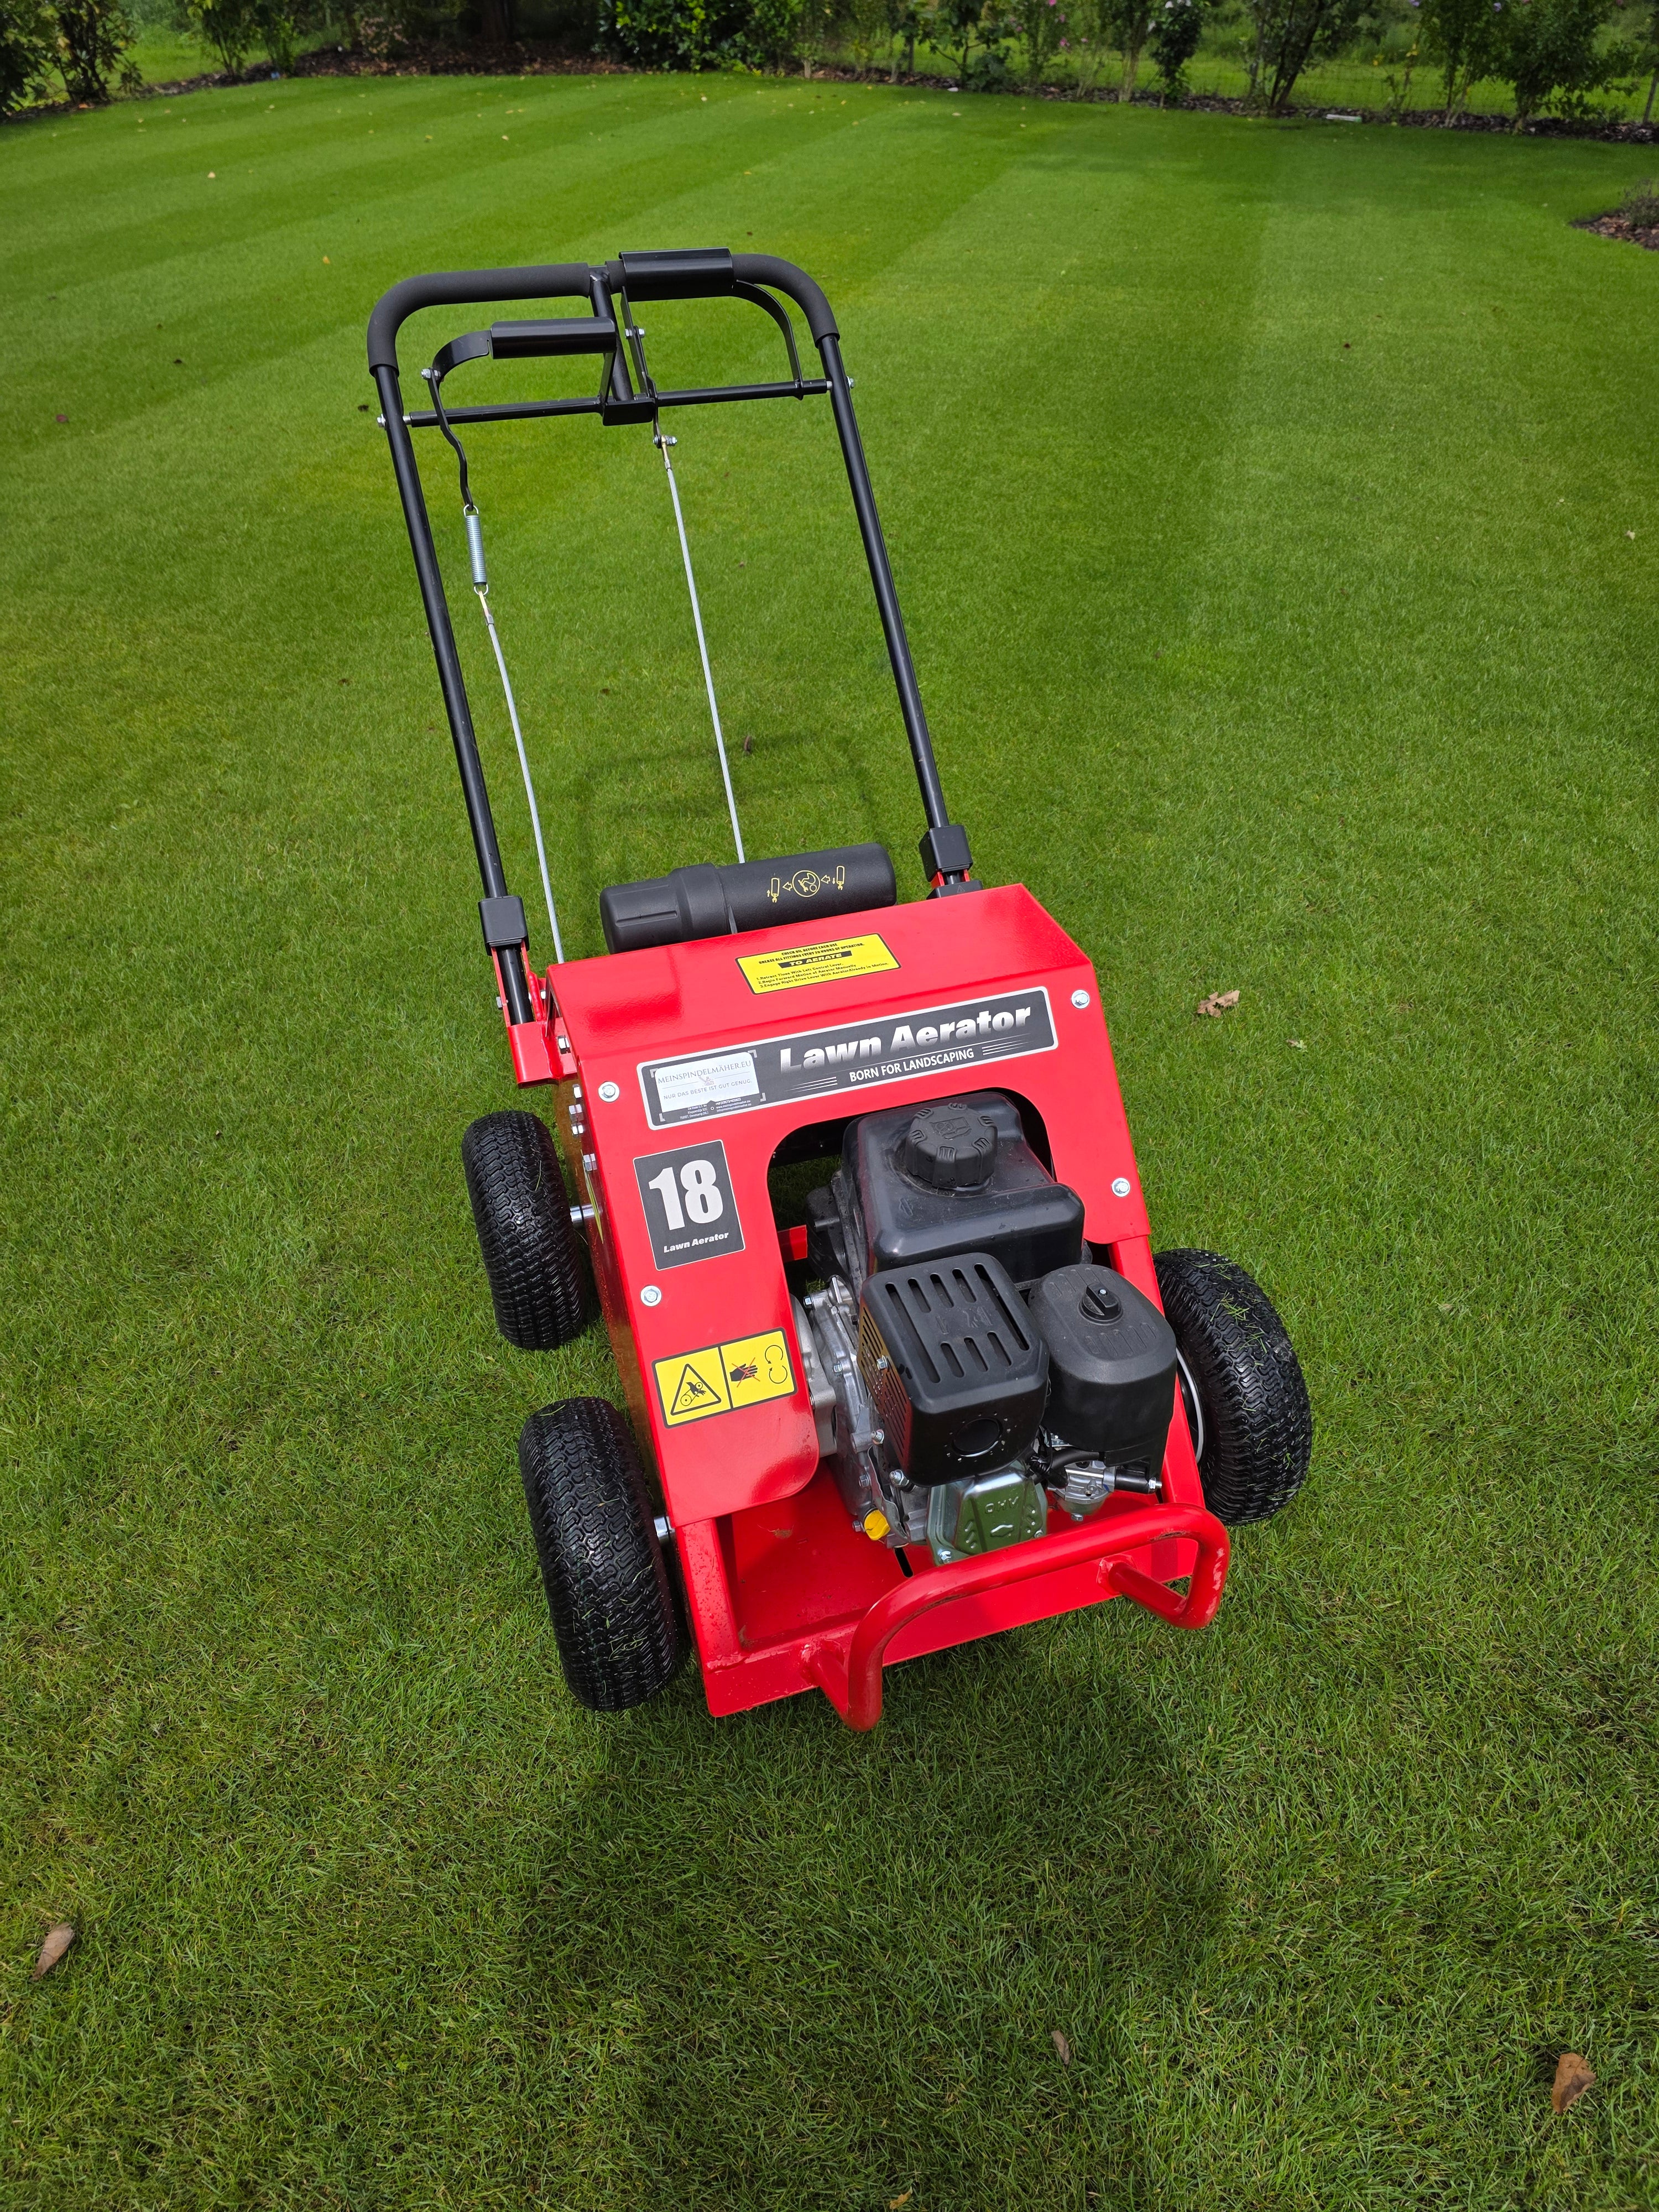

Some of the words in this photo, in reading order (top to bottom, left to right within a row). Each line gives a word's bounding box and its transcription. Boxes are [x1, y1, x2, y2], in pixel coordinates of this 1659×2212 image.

[806, 953, 842, 963] AERATE
[780, 1036, 881, 1074] Lawn
[890, 1006, 1031, 1051] Aerator
[658, 1060, 752, 1084] MEINSPINDELMÄHER.EU
[849, 1067, 879, 1082] BORN
[881, 1063, 901, 1076] FOR
[904, 1048, 975, 1072] LANDSCAPING
[648, 1160, 723, 1230] 18
[664, 1241, 690, 1253] Lawn
[691, 1232, 729, 1246] Aerator
